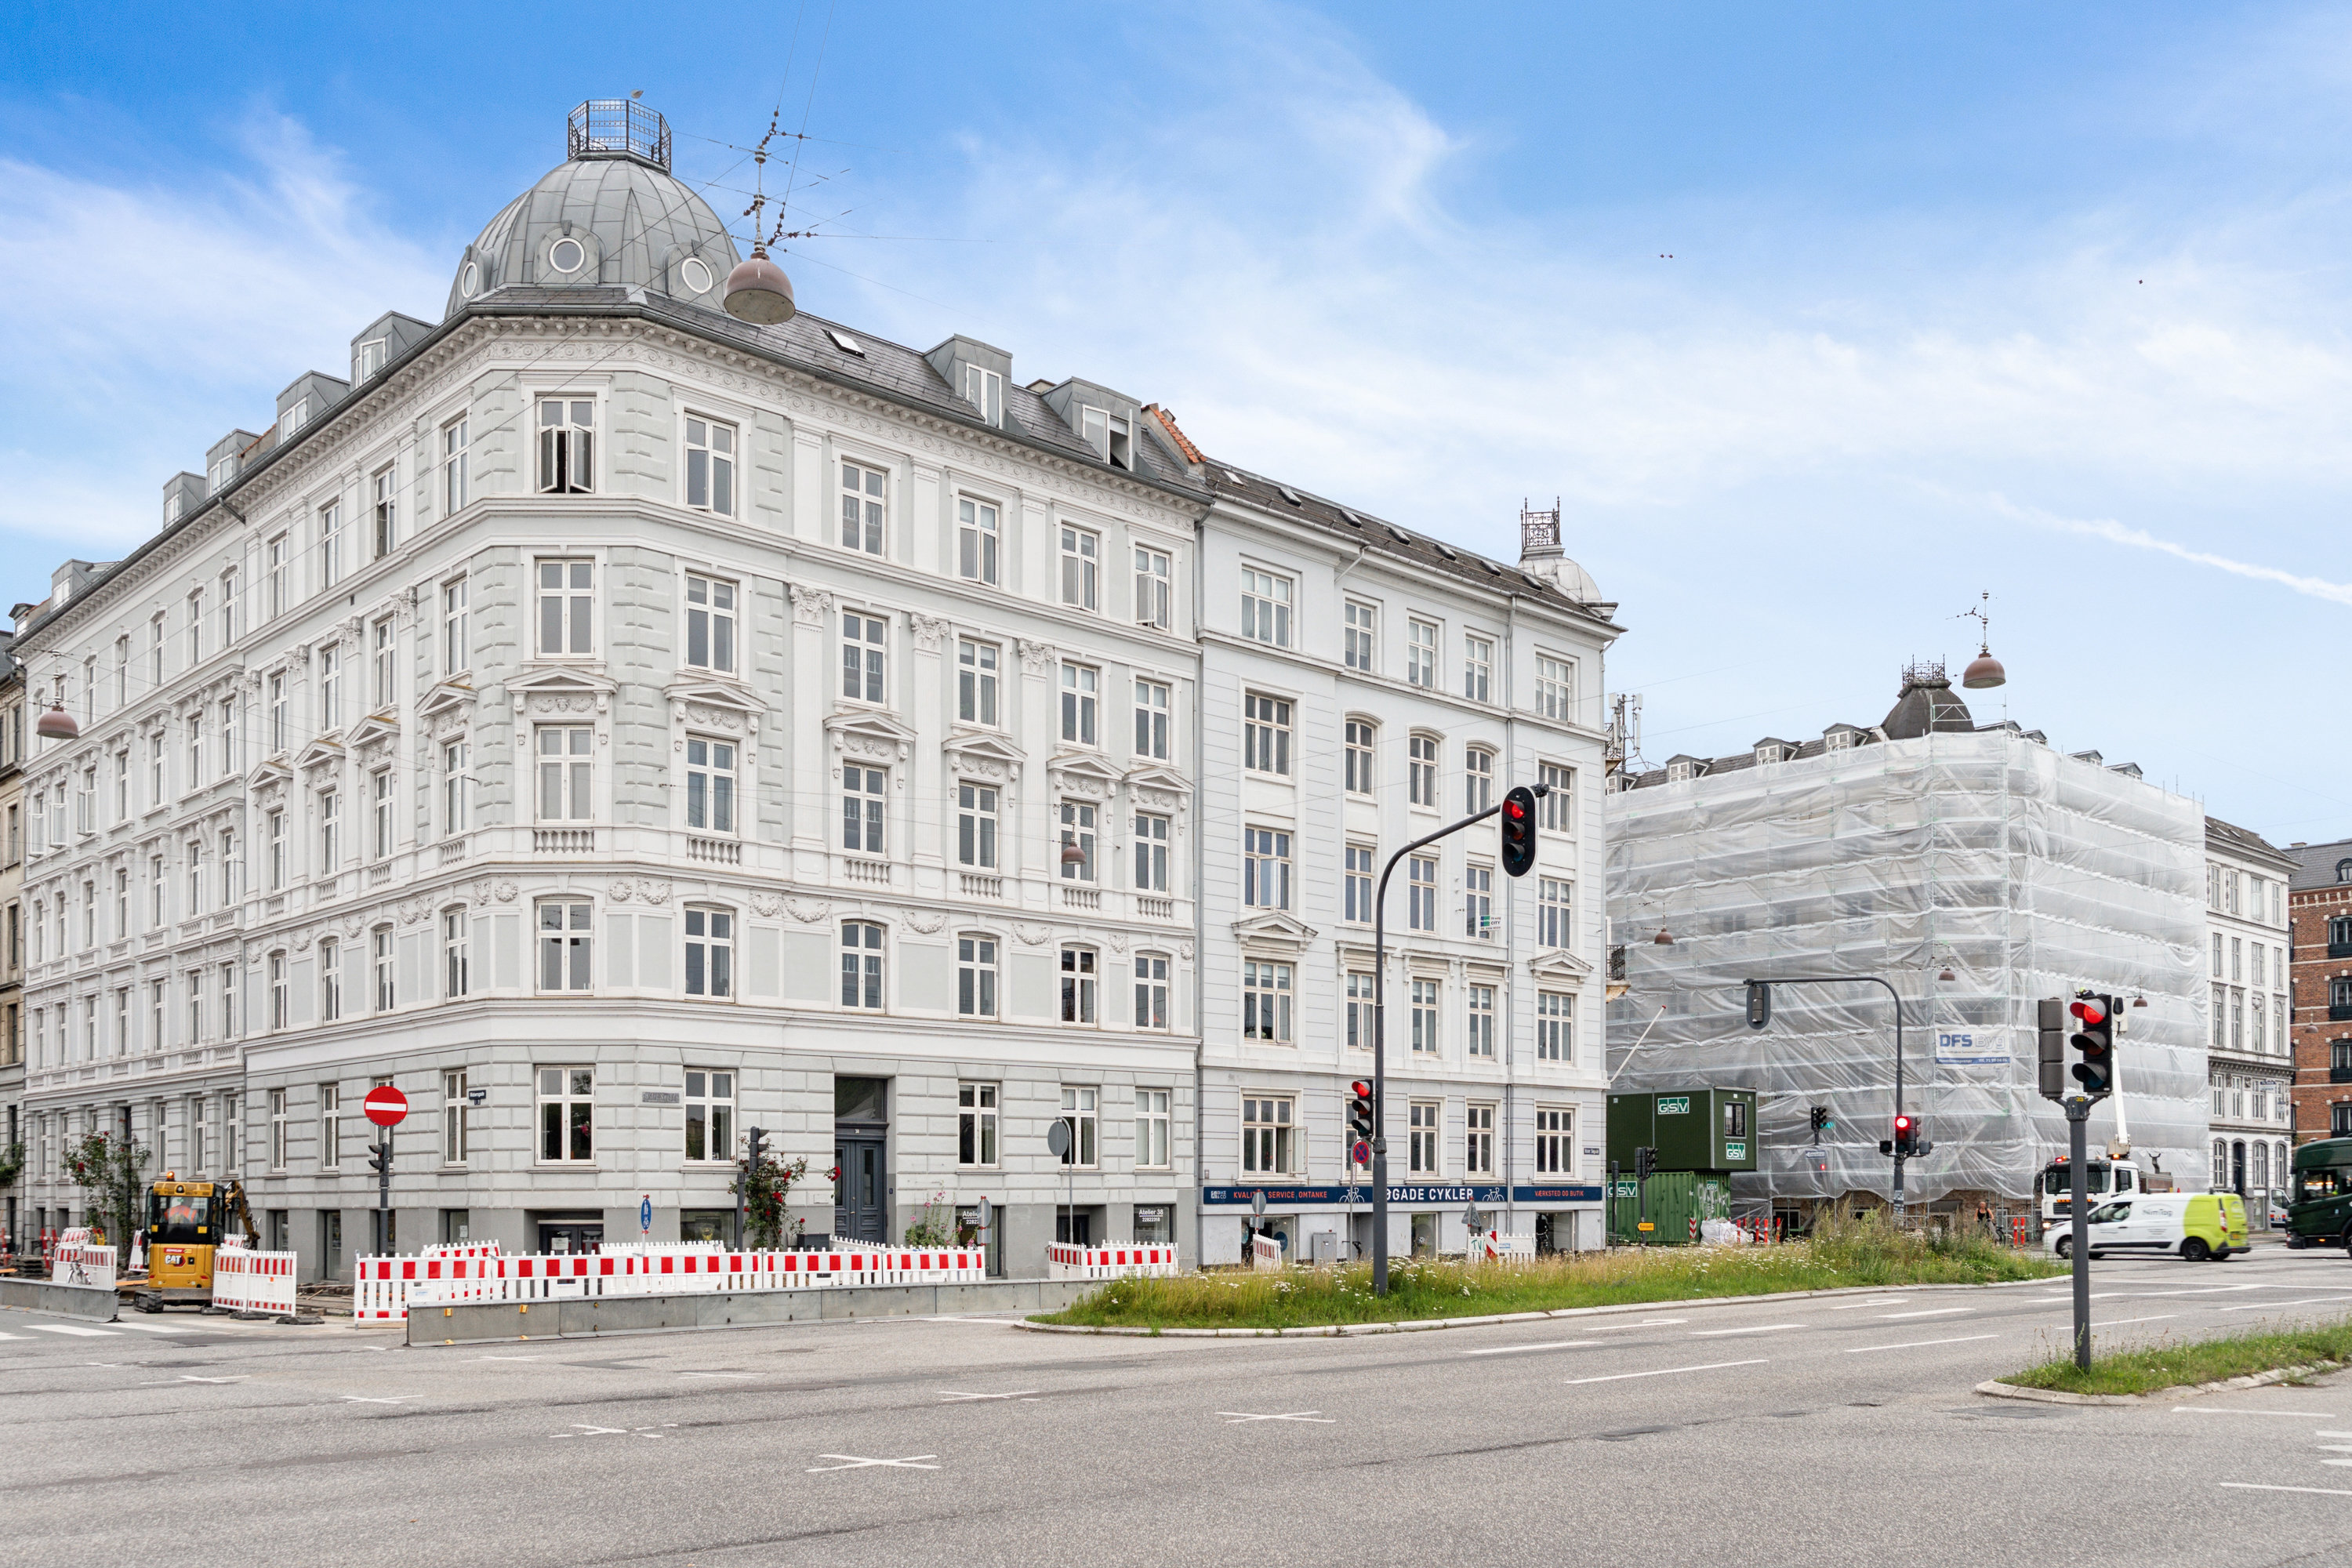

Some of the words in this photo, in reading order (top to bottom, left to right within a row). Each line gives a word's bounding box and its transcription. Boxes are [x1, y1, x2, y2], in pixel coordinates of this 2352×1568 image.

[1940, 1034, 1973, 1047] DFS
[1976, 1034, 2005, 1049] Byg
[1659, 1103, 1687, 1112] GSV
[1726, 1149, 1744, 1158] GSV
[165, 1255, 182, 1264] CAT
